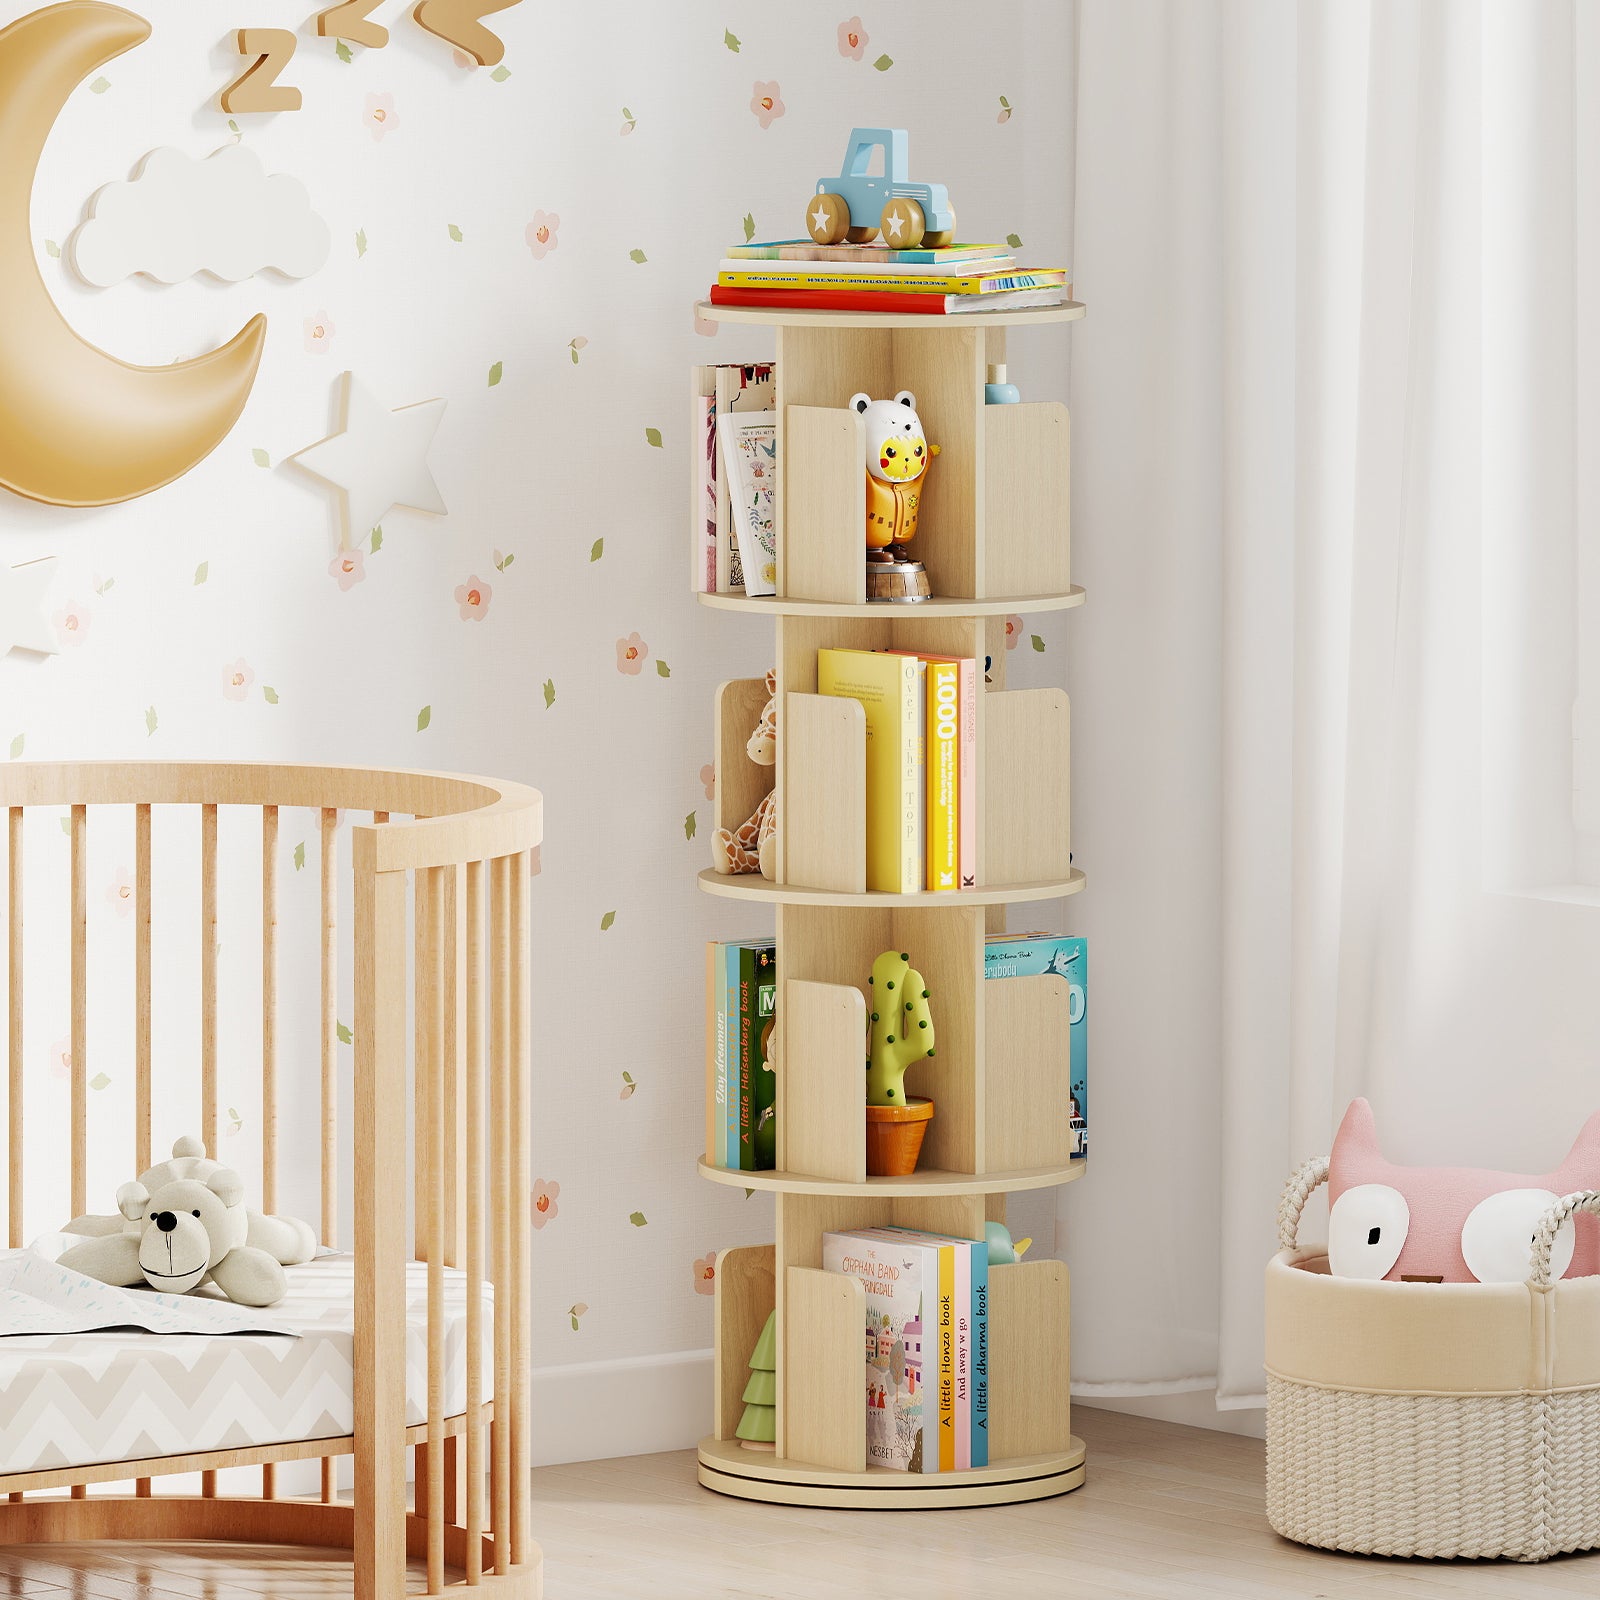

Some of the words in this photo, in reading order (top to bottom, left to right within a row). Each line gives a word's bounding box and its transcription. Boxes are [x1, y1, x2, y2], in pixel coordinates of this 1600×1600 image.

[937, 671, 956, 740] 1000
[740, 981, 748, 1012] book
[714, 1011, 725, 1073] dreamers
[740, 1017, 751, 1090] Heisenberg
[715, 1075, 727, 1104] Day
[741, 1095, 749, 1127] little
[741, 1133, 749, 1145] A
[842, 1256, 875, 1277] ORPHAN
[877, 1263, 900, 1281] BAND
[867, 1249, 876, 1259] THE
[940, 1295, 950, 1326] book
[975, 1285, 986, 1317] book
[959, 1317, 968, 1331] go
[959, 1334, 966, 1344] w
[941, 1332, 951, 1373] Honzo
[959, 1347, 968, 1374] away
[976, 1322, 987, 1375] dharma
[940, 1379, 951, 1411] little
[957, 1377, 966, 1401] And
[976, 1381, 987, 1413] little
[942, 1416, 951, 1428] A
[977, 1417, 987, 1430] A
